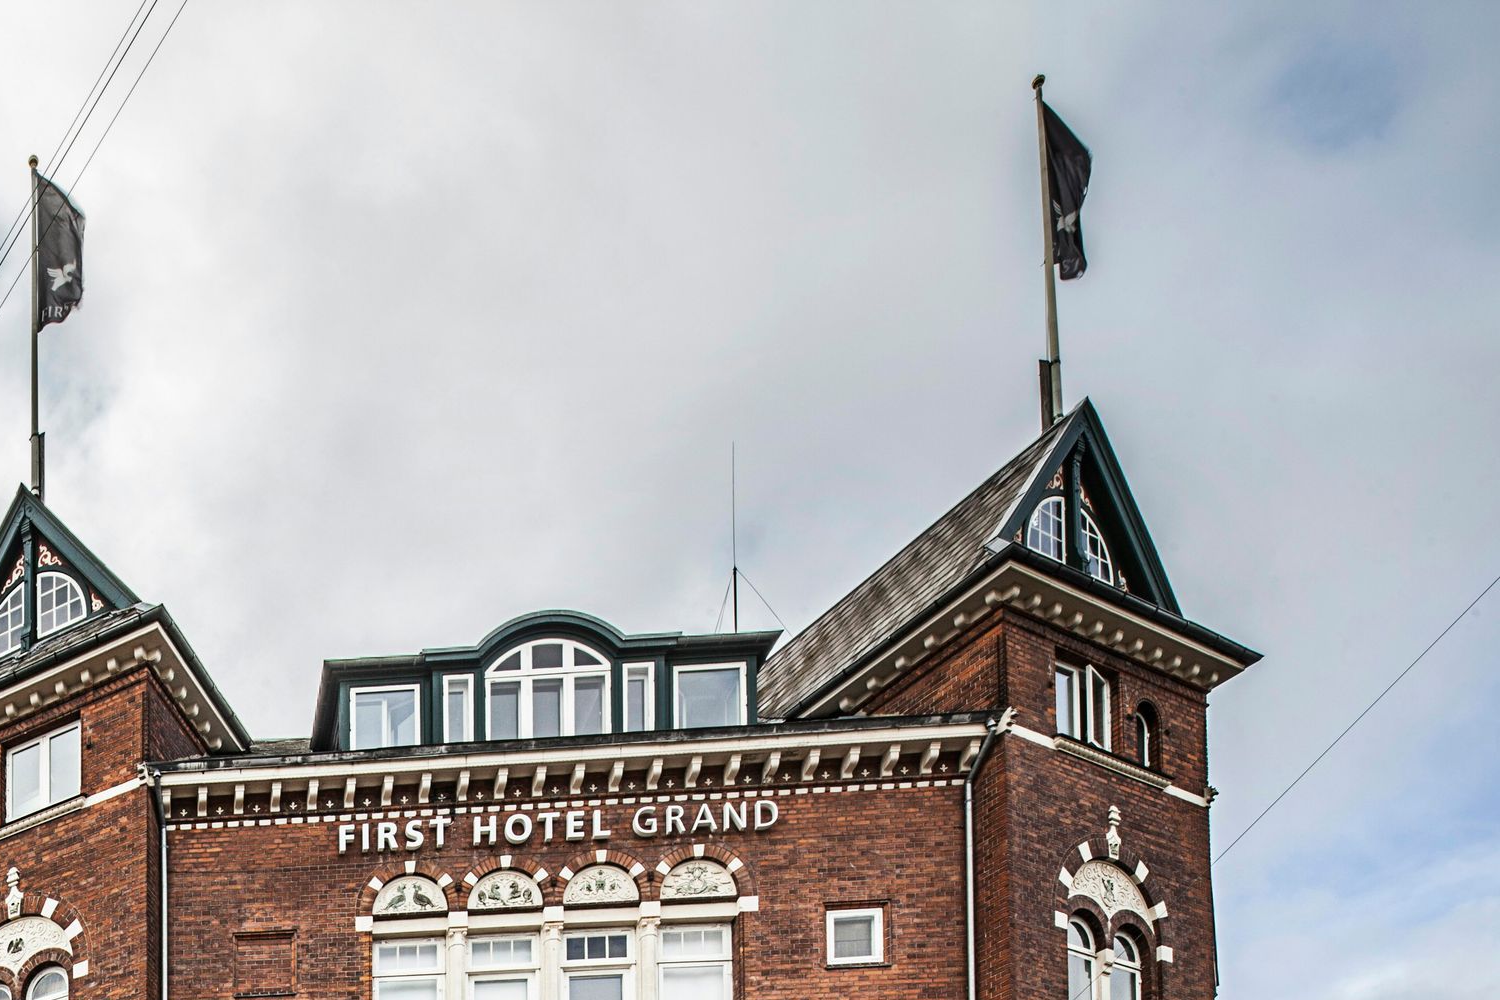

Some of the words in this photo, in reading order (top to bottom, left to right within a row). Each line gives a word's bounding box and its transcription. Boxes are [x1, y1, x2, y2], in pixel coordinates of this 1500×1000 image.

[338, 815, 453, 854] FIRST
[473, 809, 612, 846] HOTEL
[632, 800, 779, 838] GRAND
